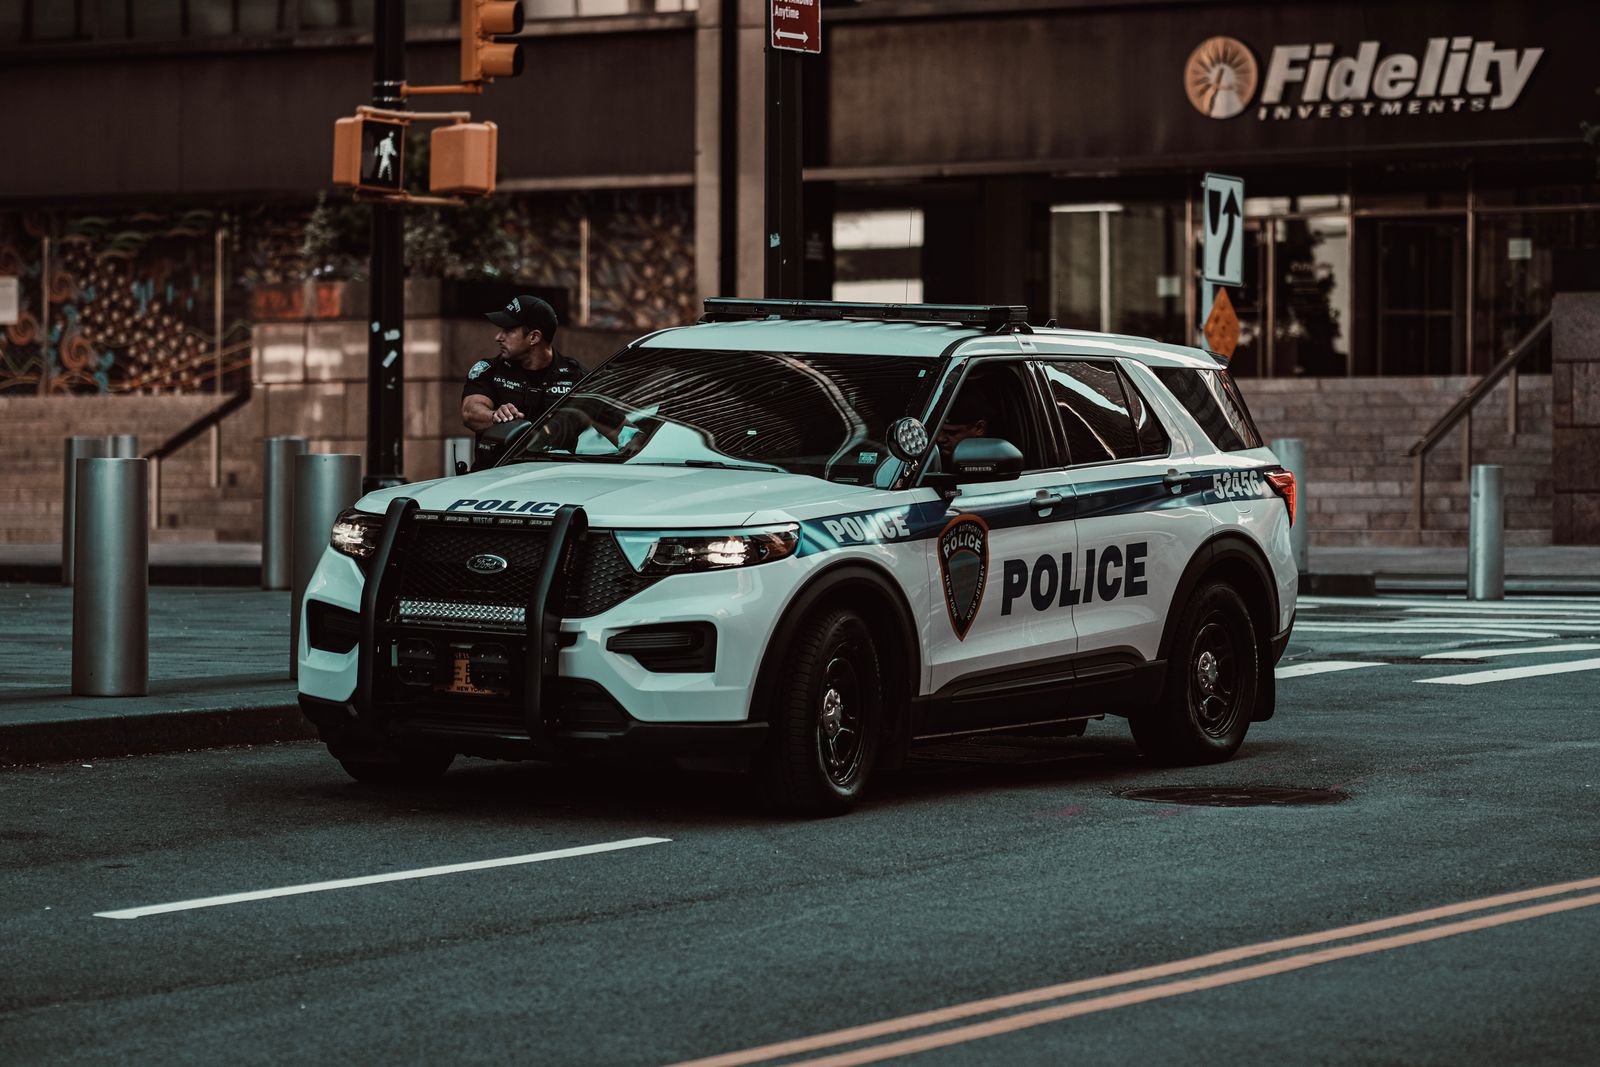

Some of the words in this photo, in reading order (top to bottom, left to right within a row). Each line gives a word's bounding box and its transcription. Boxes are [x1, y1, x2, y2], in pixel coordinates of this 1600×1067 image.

[775, 5, 799, 20] Anytime
[1261, 36, 1544, 110] Fidelity
[1259, 97, 1485, 120] INVESTMENTS
[1213, 470, 1262, 499] 52456
[446, 499, 582, 514] POLIC
[823, 511, 910, 543] POLICE
[942, 527, 957, 544] PORT
[958, 523, 984, 539] AUTHORITY
[943, 532, 982, 558] POLICE
[474, 558, 498, 570] Ford
[1001, 542, 1148, 616] POLICE
[967, 600, 976, 621] NEW
[975, 564, 985, 600] JERSEY
